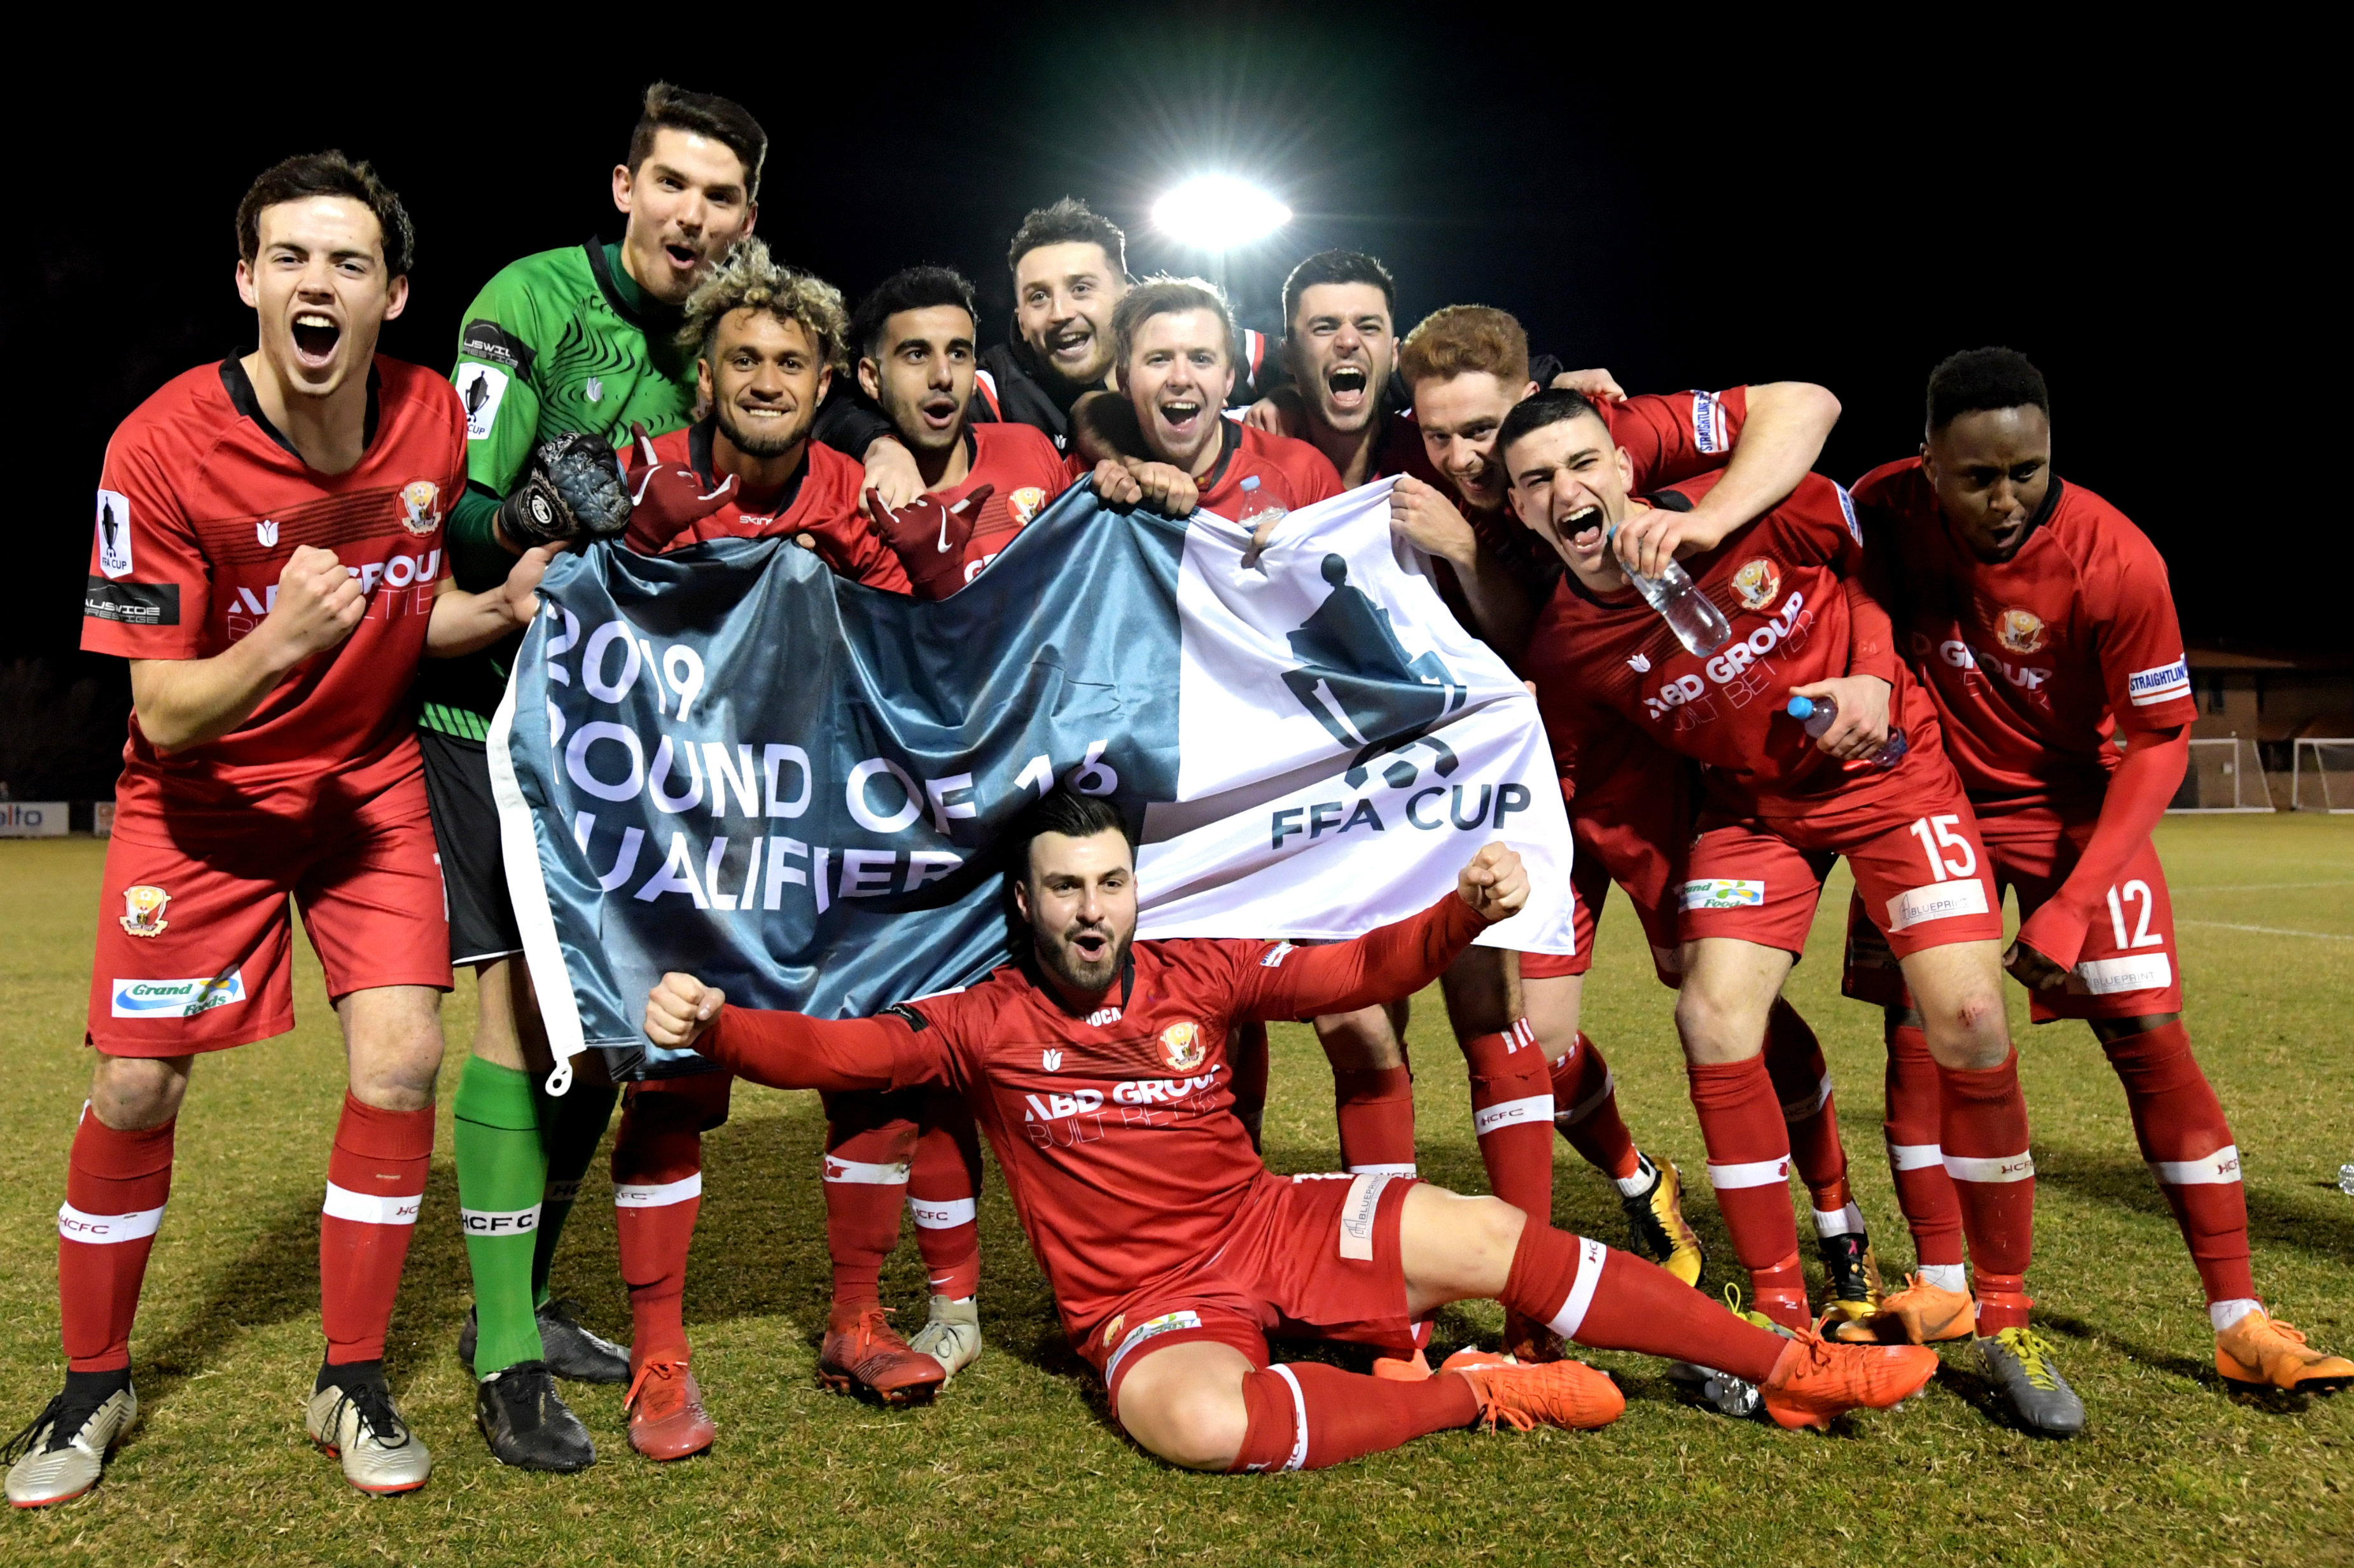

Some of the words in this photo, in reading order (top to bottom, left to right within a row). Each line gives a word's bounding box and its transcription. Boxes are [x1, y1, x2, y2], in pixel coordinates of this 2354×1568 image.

[468, 424, 485, 435] CUP
[111, 559, 127, 570] CUP
[546, 602, 704, 722] 2019
[1643, 674, 1704, 719] ABD
[1706, 592, 1803, 683] GROUP
[2129, 665, 2186, 691] STRAIGHTLIN
[547, 694, 812, 820] OUND
[846, 757, 977, 835] OF
[1013, 739, 1118, 800] 16
[1272, 798, 1385, 850] FFA
[1405, 782, 1531, 831] CUP
[560, 807, 964, 914] UALIFIER
[1909, 814, 1977, 882] 15
[2107, 880, 2163, 950] 12
[132, 983, 193, 996] Grand
[2093, 971, 2155, 986] BLUEPRINT
[1025, 1089, 1104, 1121] ABD
[1480, 1108, 1524, 1126] HCFC
[1027, 1111, 1107, 1149] BUILT
[59, 1214, 109, 1235] HCFC
[461, 1213, 533, 1231] HCFC
